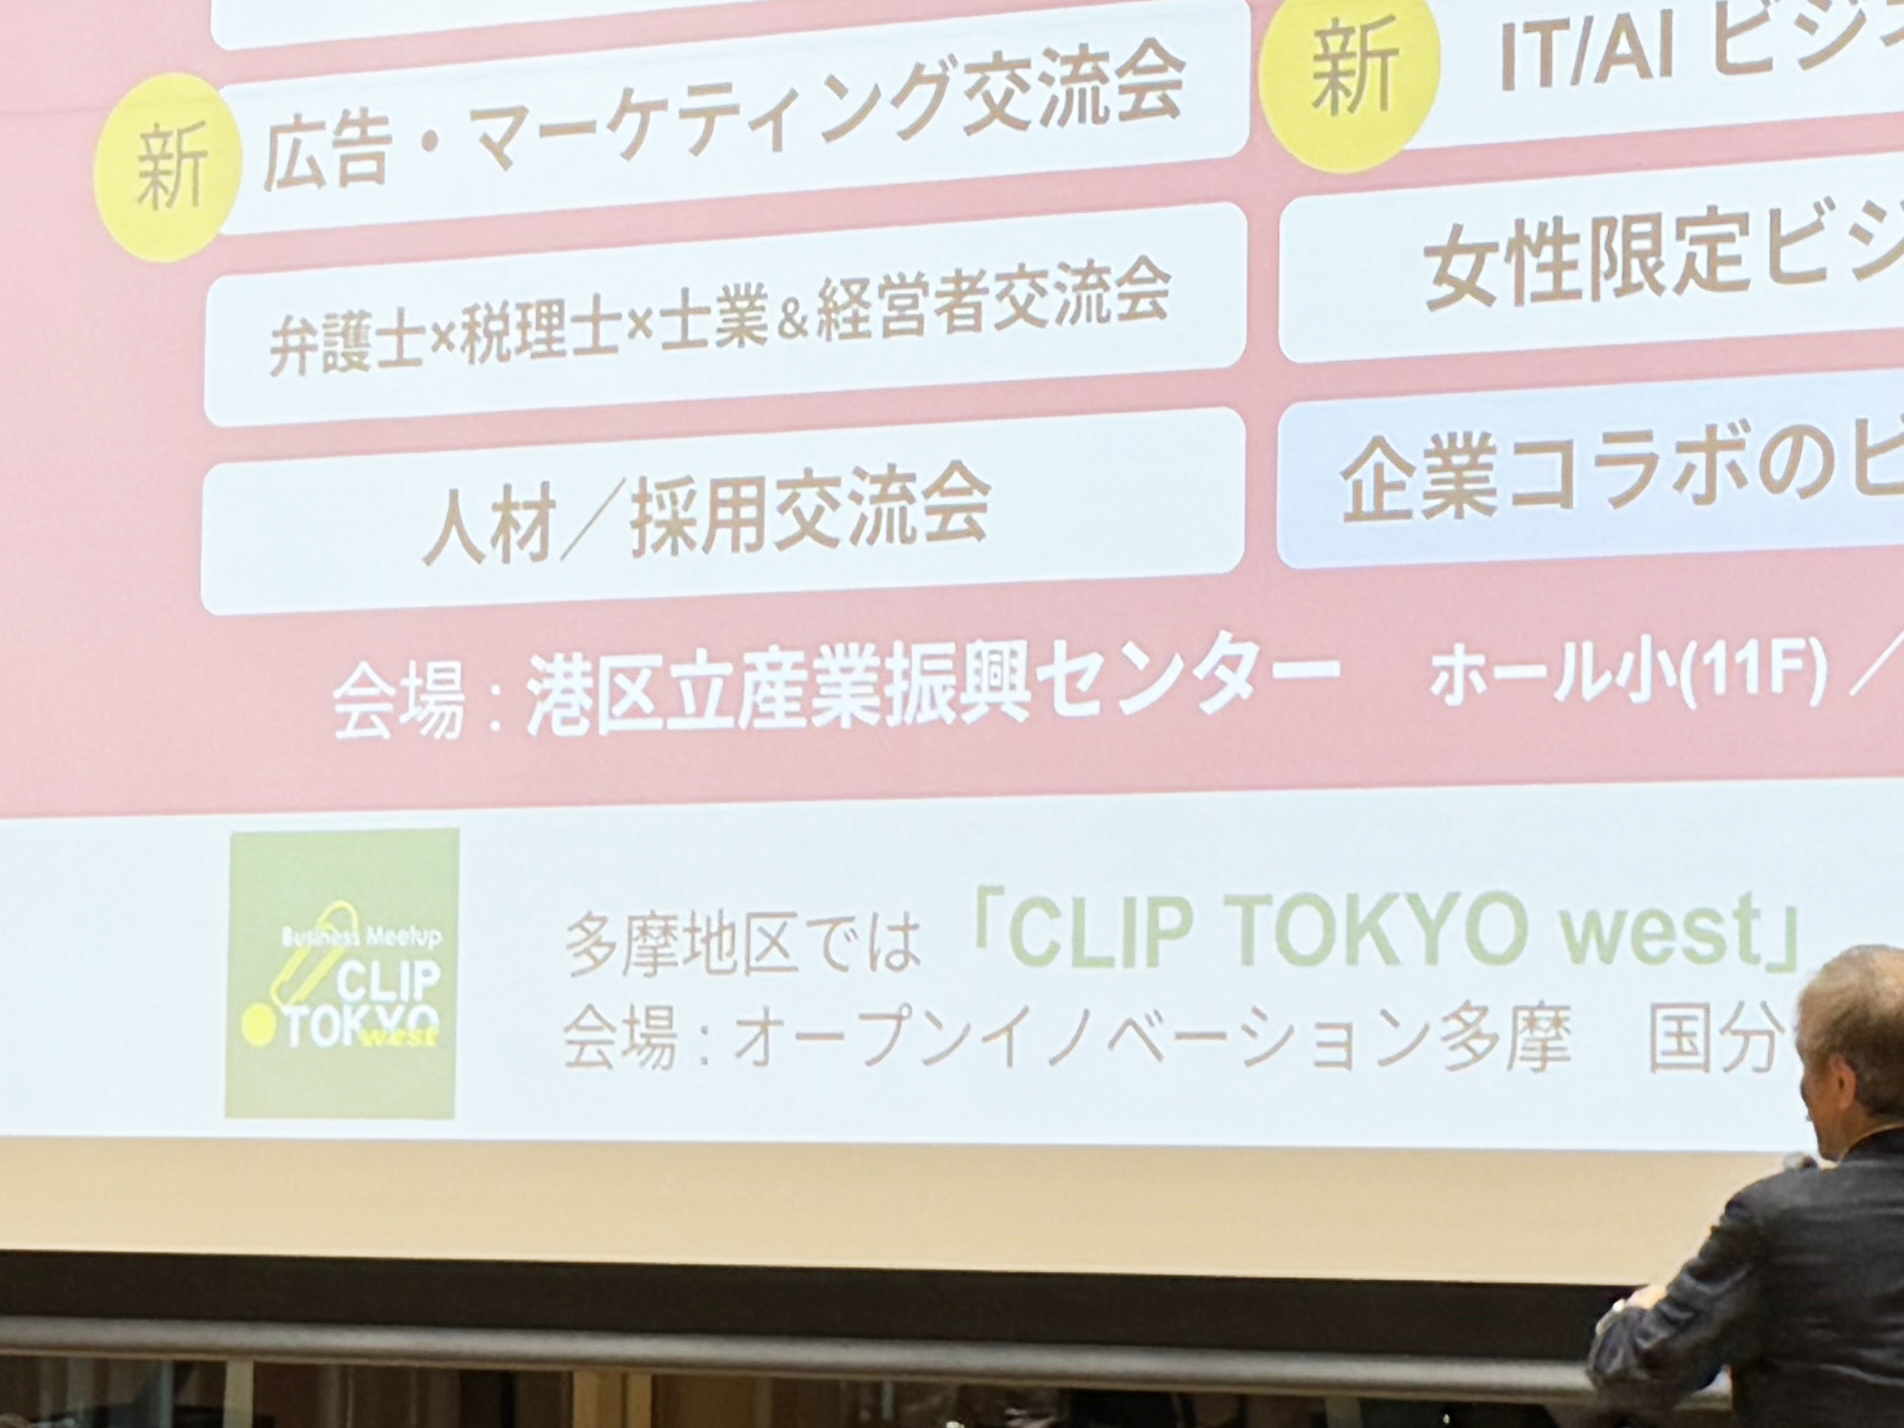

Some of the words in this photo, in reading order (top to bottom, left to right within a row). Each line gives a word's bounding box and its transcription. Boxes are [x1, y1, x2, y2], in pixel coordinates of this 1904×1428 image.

[1310, 11, 1401, 118] 新
[1500, 7, 1676, 92] IT/AI
[263, 36, 1187, 192] 広告・マーケティング交流会
[136, 117, 209, 213] 新
[1224, 887, 1530, 967] TOKYO
[336, 958, 442, 1003] CLIP
